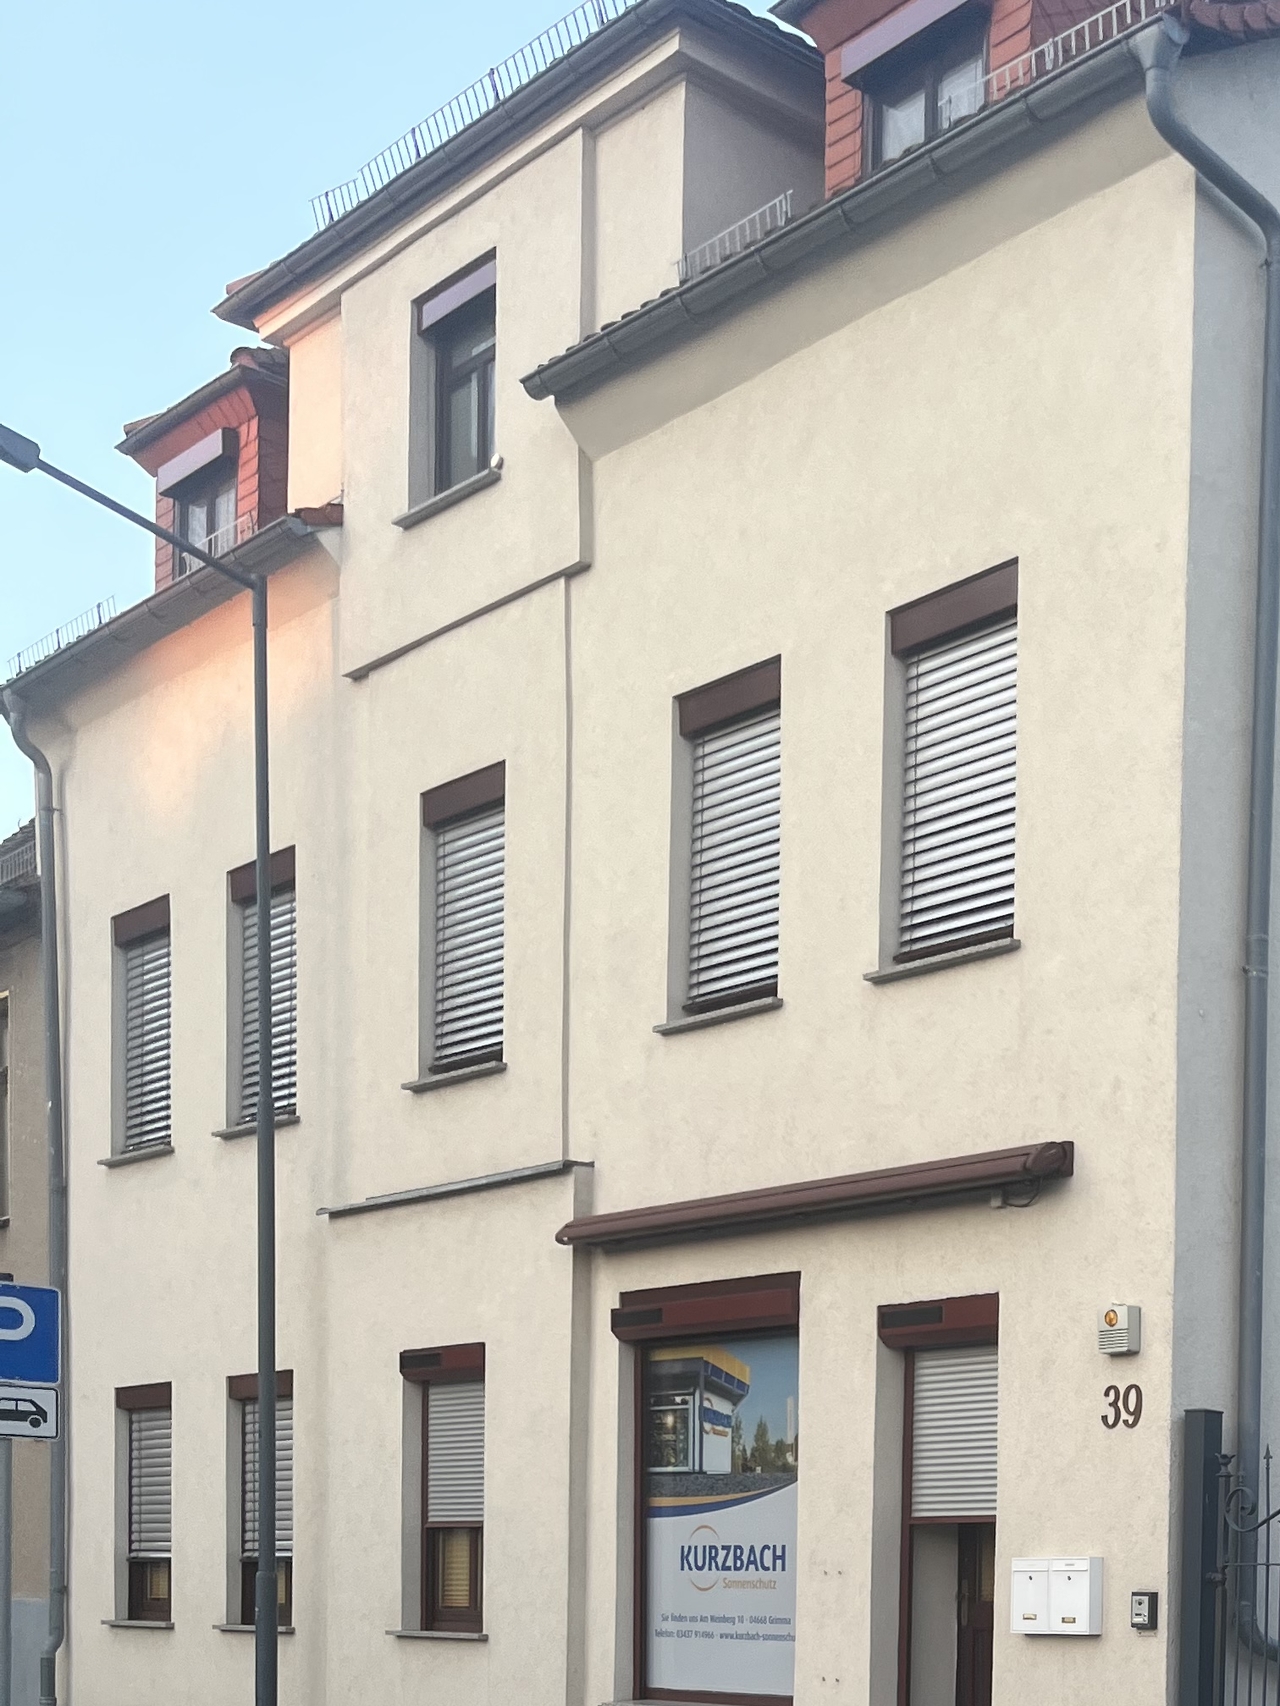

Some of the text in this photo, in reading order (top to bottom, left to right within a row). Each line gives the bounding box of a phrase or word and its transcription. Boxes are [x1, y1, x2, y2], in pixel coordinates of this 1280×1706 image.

[1101, 1384, 1143, 1429] 39
[680, 1544, 786, 1572] KURZBACH
[722, 1577, 777, 1590] Sonnenschutz
[661, 1613, 669, 1622] Sie
[688, 1615, 699, 1623] uns
[768, 1615, 792, 1625] Grimma
